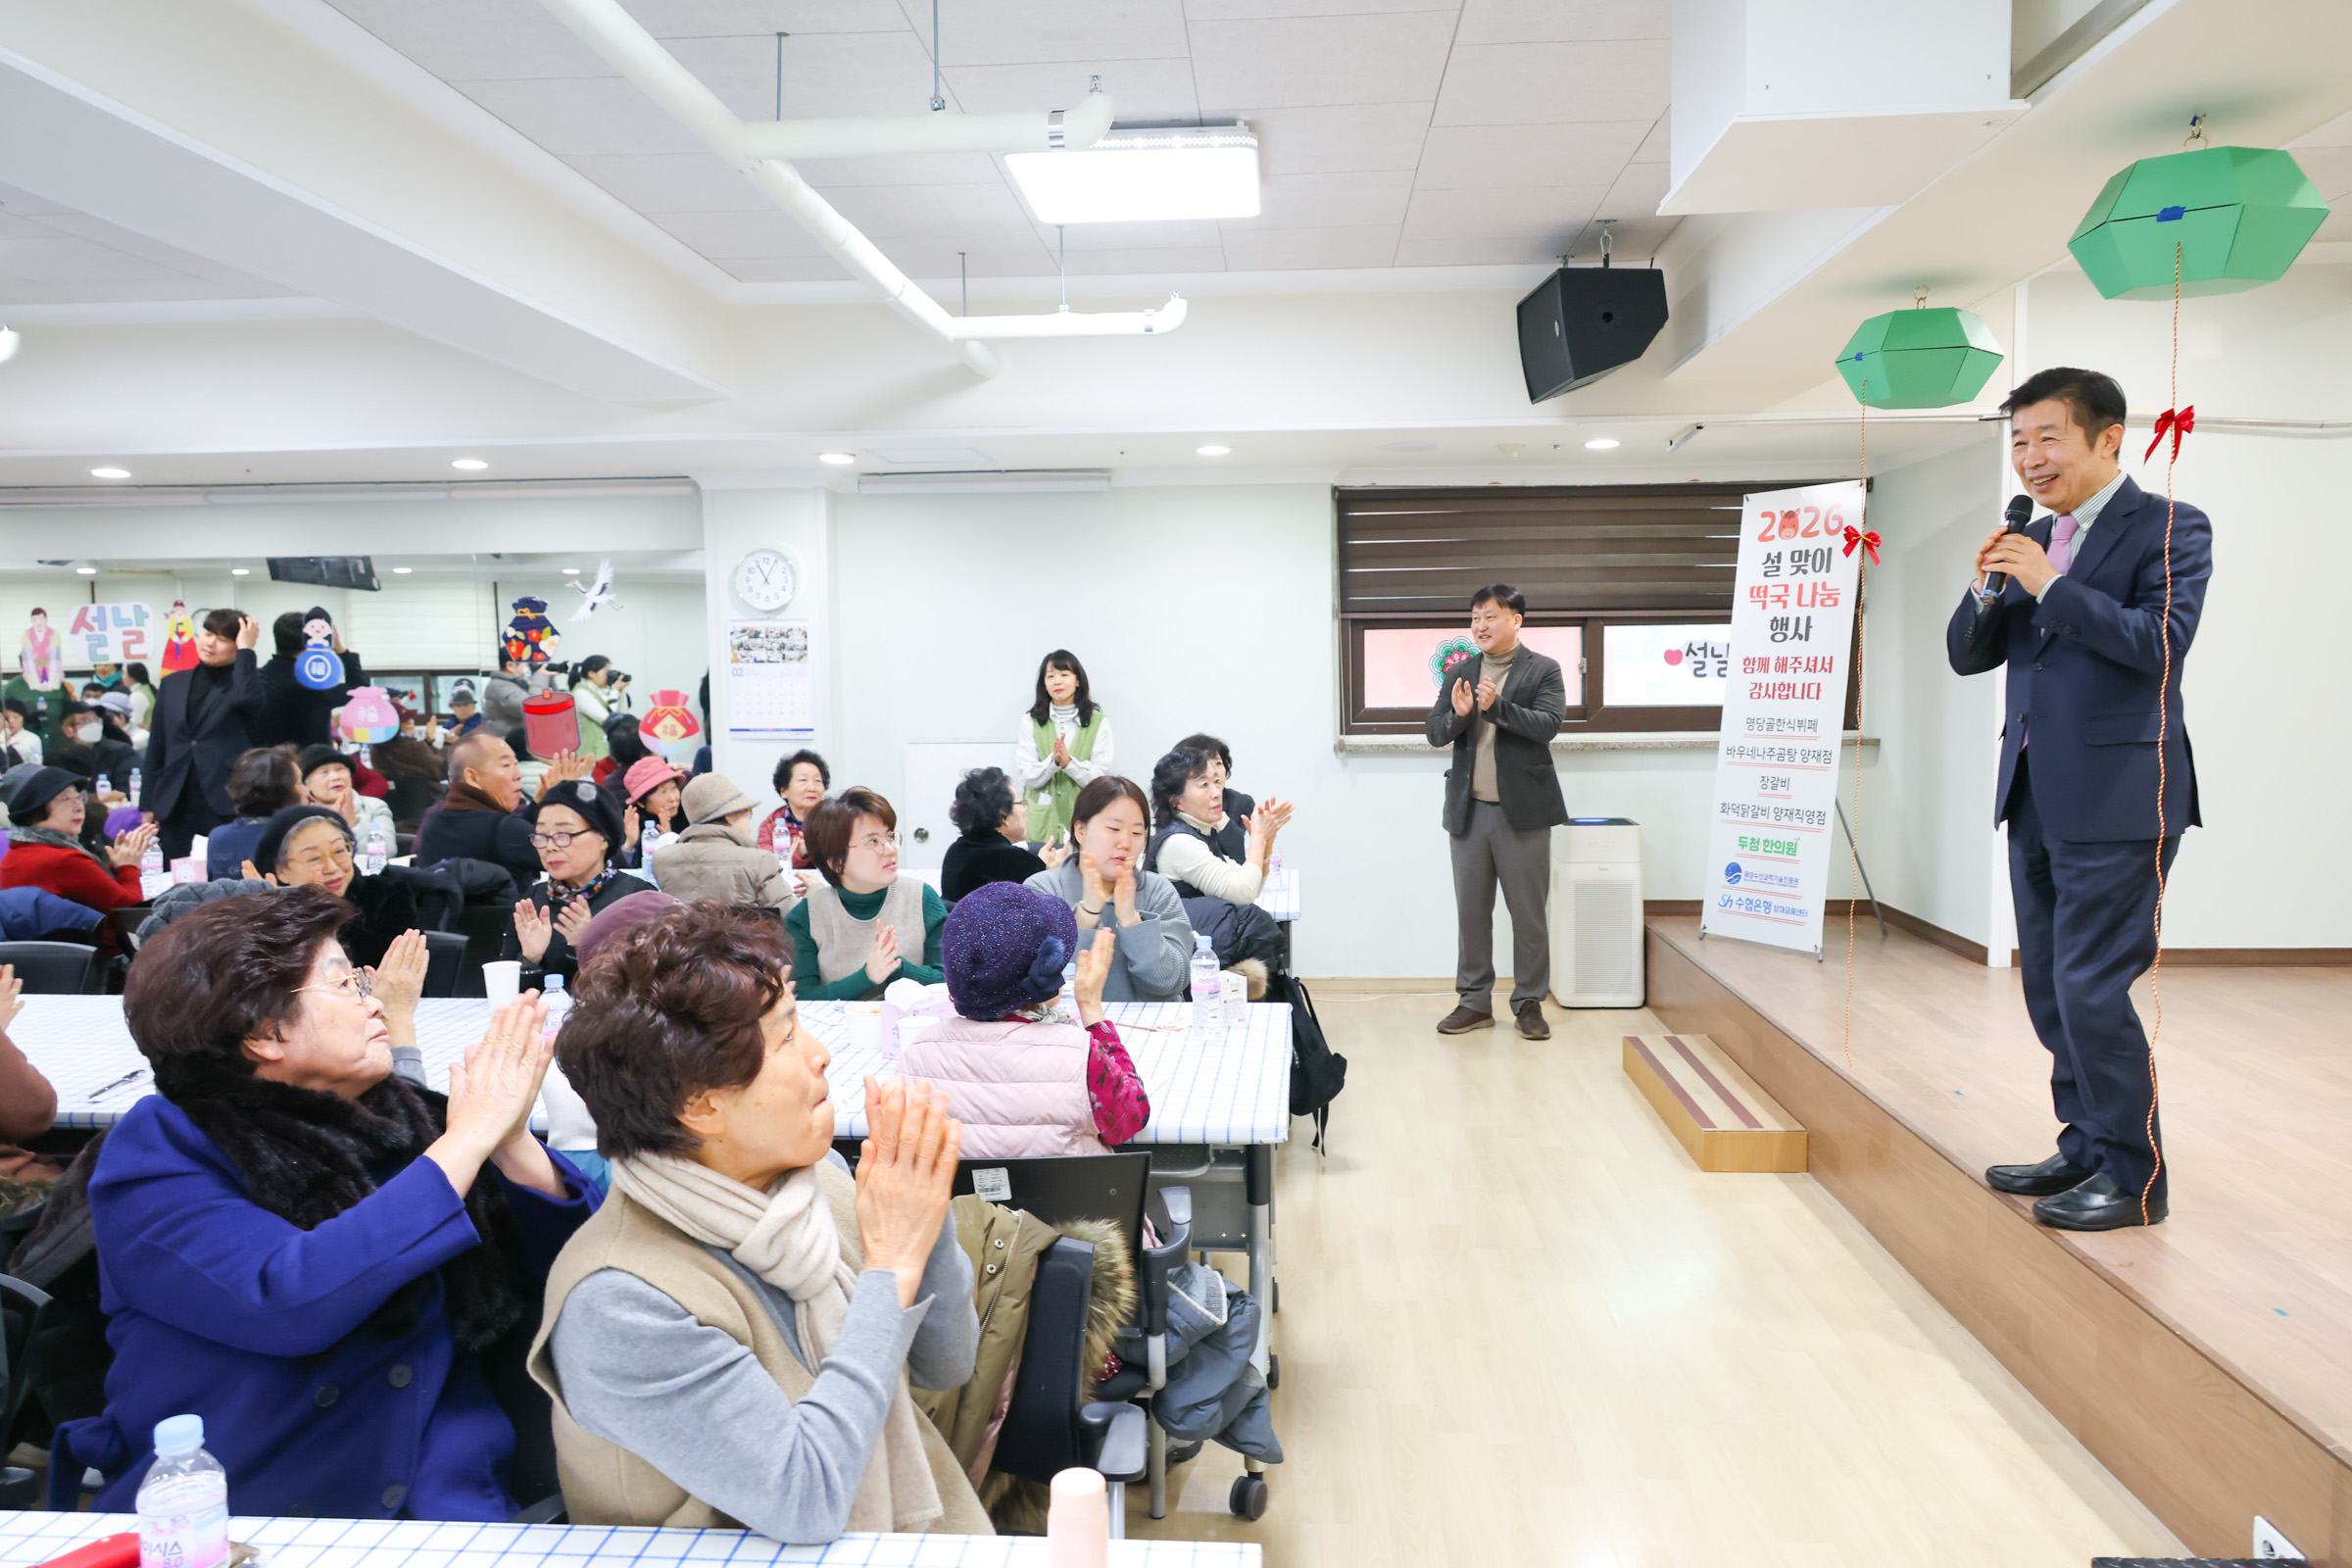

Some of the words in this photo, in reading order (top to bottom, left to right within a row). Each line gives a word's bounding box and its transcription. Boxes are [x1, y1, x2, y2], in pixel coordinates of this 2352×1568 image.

[1757, 503, 1843, 542] 2026
[1762, 551, 1782, 577] 설
[1789, 547, 1833, 576] 맞이
[1749, 584, 1789, 611] 떡국
[1797, 581, 1840, 608] 나눔
[71, 604, 149, 662] 설날
[1770, 615, 1813, 643] 행사
[731, 667, 744, 677] 02
[1742, 656, 1770, 674] 함께
[1774, 656, 1834, 674] 해주셔서
[1749, 682, 1822, 701] 감사합니다
[1745, 717, 1818, 733] 명당골한식뷔페
[1726, 745, 1797, 762] 바우네나주곰탕
[1800, 749, 1833, 764] 양재점
[1760, 775, 1790, 791] 장갈비
[1720, 802, 1770, 819] 화덕닭갈비
[1773, 807, 1827, 825] 양재직영점
[1762, 838, 1798, 857] 한의원
[1718, 893, 1734, 908] Sh
[1735, 897, 1773, 914] 수협은행
